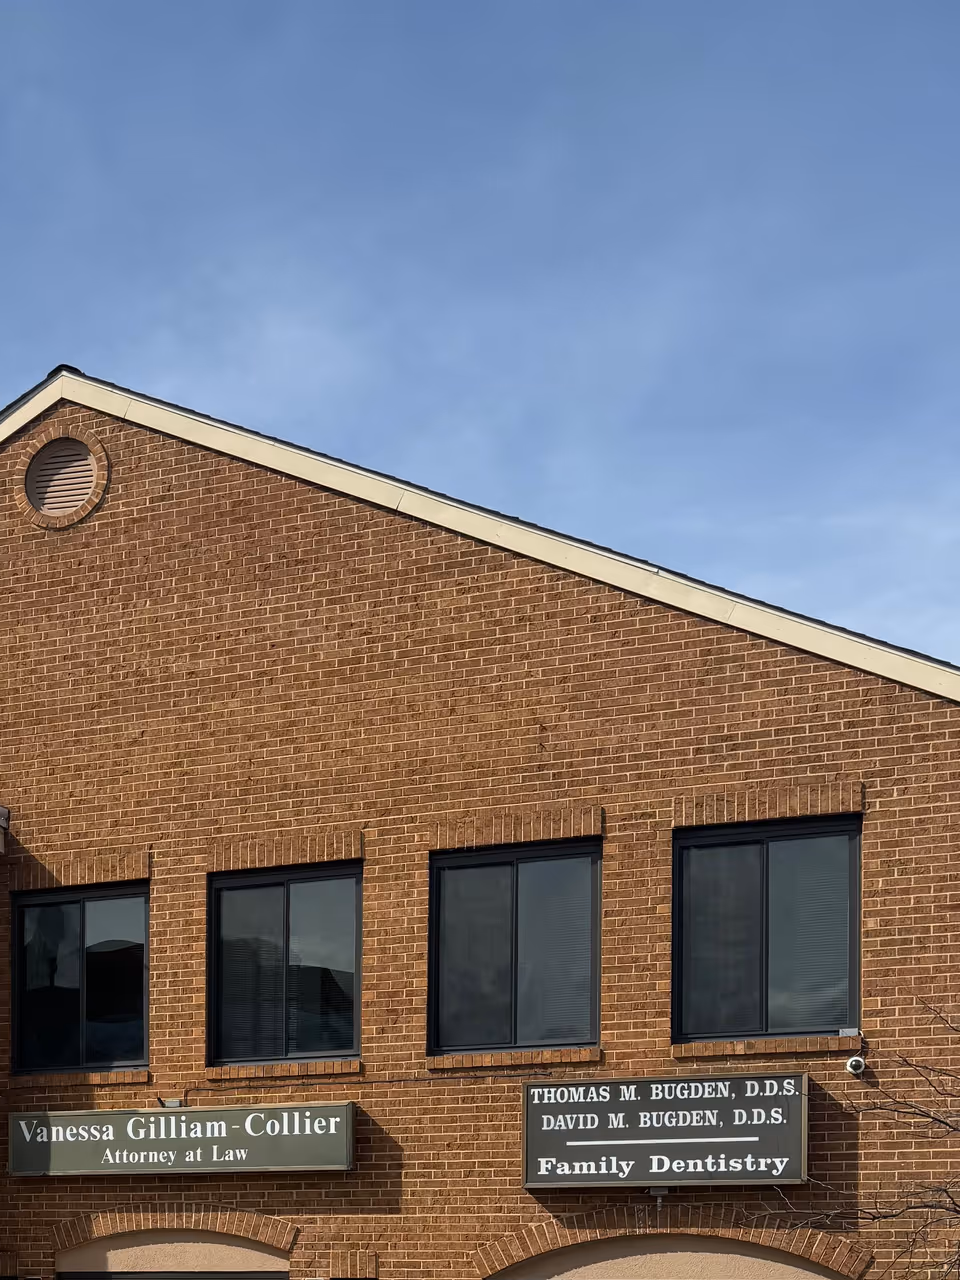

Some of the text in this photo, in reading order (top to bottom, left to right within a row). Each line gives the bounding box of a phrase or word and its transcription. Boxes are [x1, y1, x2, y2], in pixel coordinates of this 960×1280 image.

[530, 1079, 800, 1104] THOMAS M. BUGDEN, D.D.S.
[18, 1120, 115, 1142] Vanessa
[541, 1108, 787, 1131] DAVID M. BUGDEN, D.D.S.
[100, 1145, 249, 1166] Attorney at Law
[537, 1153, 790, 1178] Family Dentistry
